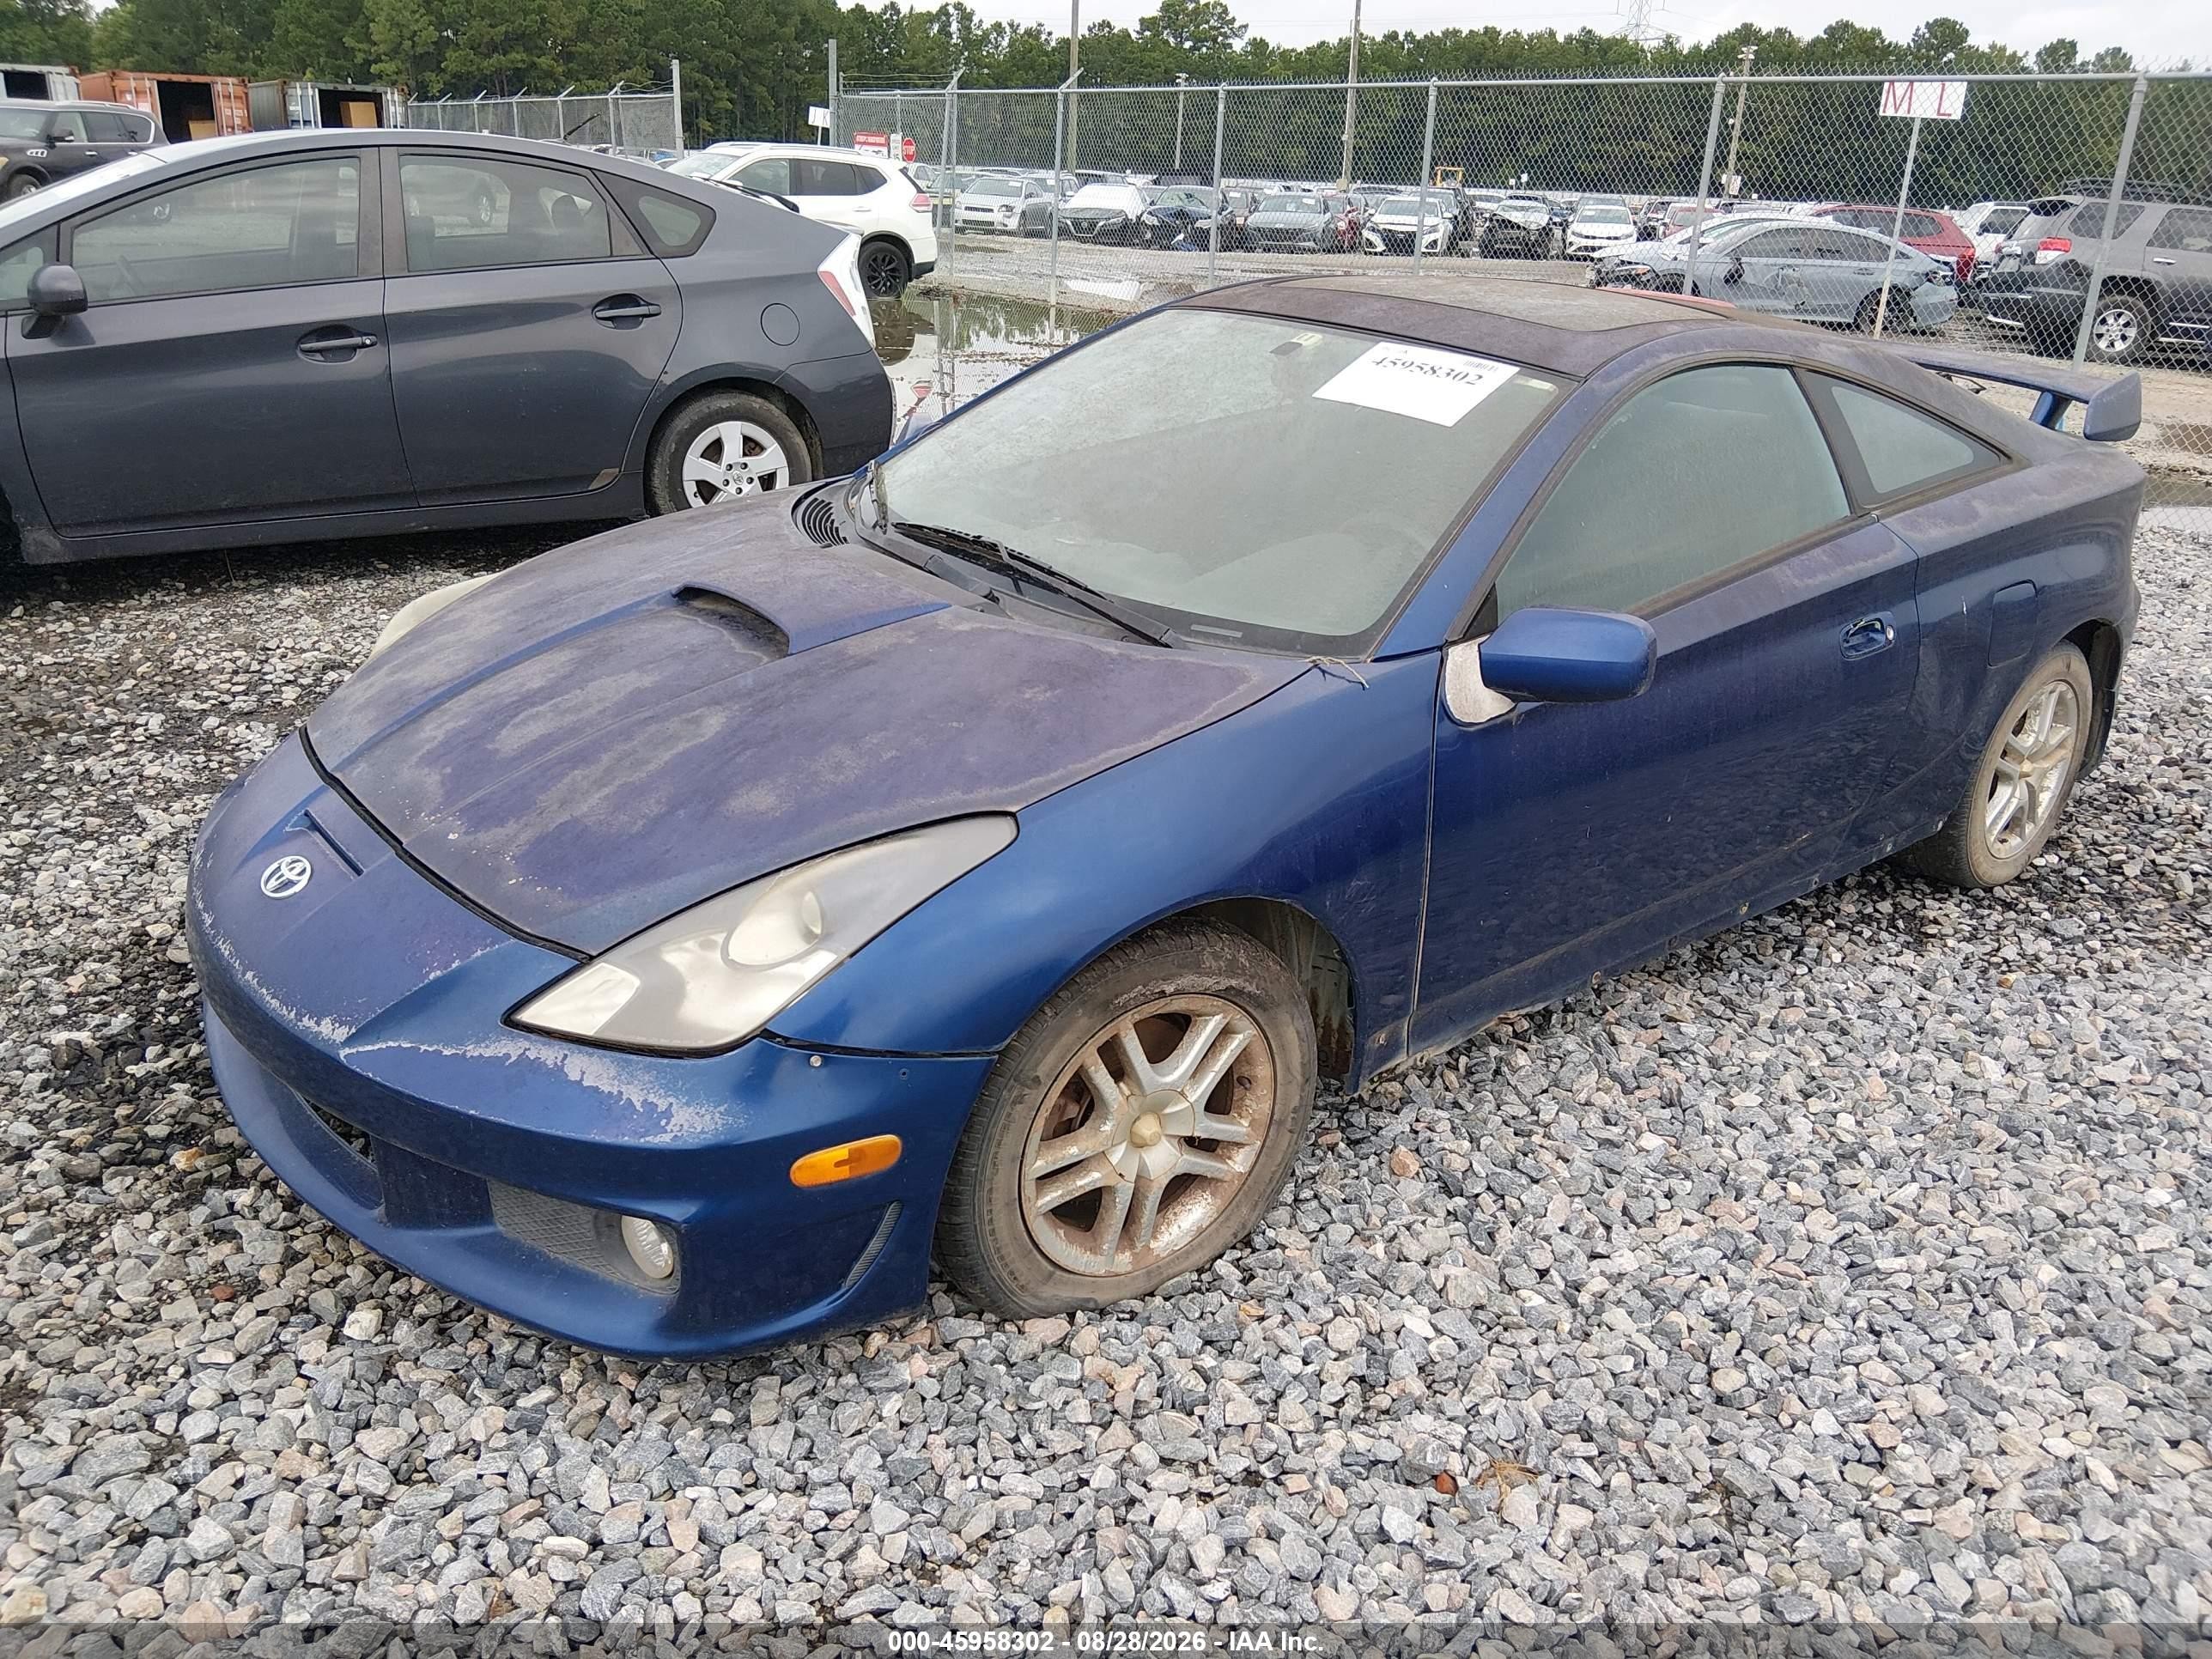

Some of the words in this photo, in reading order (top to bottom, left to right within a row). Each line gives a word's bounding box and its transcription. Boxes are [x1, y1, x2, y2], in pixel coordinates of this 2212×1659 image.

[1881, 81, 1914, 114] M
[1936, 82, 1952, 117] L
[811, 109, 817, 125] J
[902, 145, 916, 156] STOP
[1371, 356, 1484, 386] 45958302
